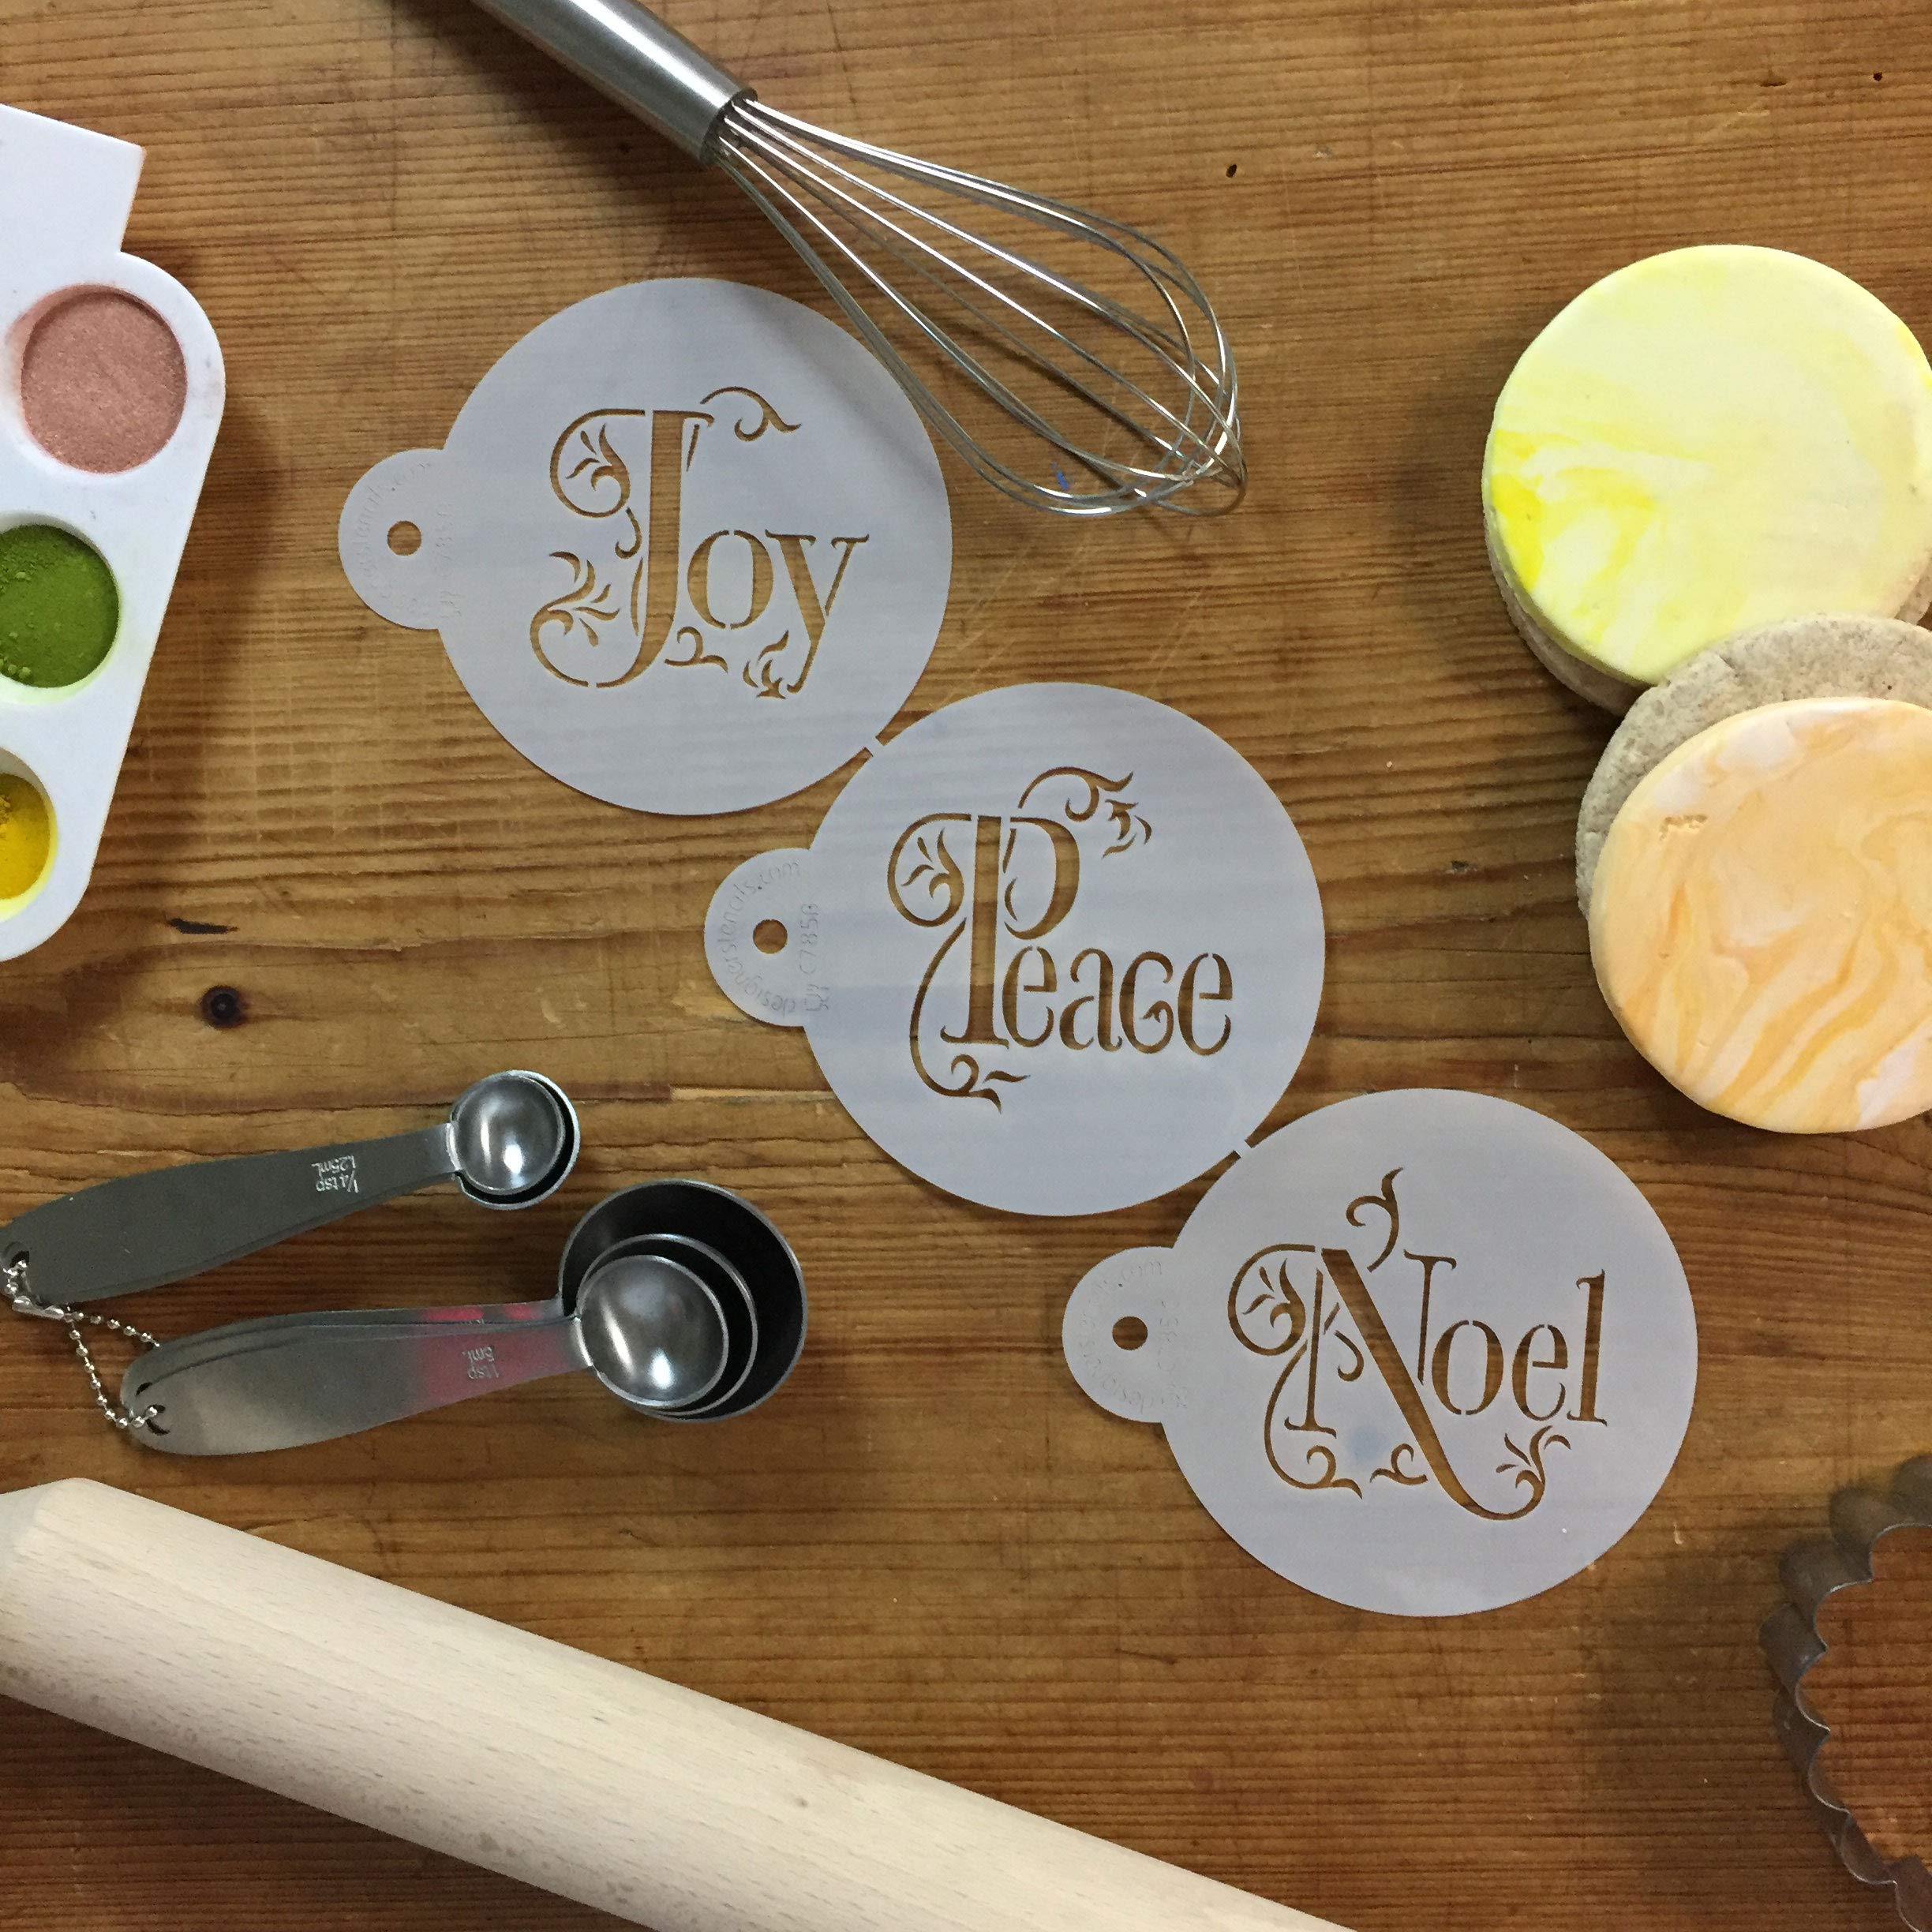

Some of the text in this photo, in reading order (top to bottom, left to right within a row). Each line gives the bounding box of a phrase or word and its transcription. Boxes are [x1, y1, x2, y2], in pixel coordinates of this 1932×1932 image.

[530, 386, 870, 699] Joy
[887, 766, 1233, 1114] Peace
[1228, 1167, 1608, 1520] Noel
